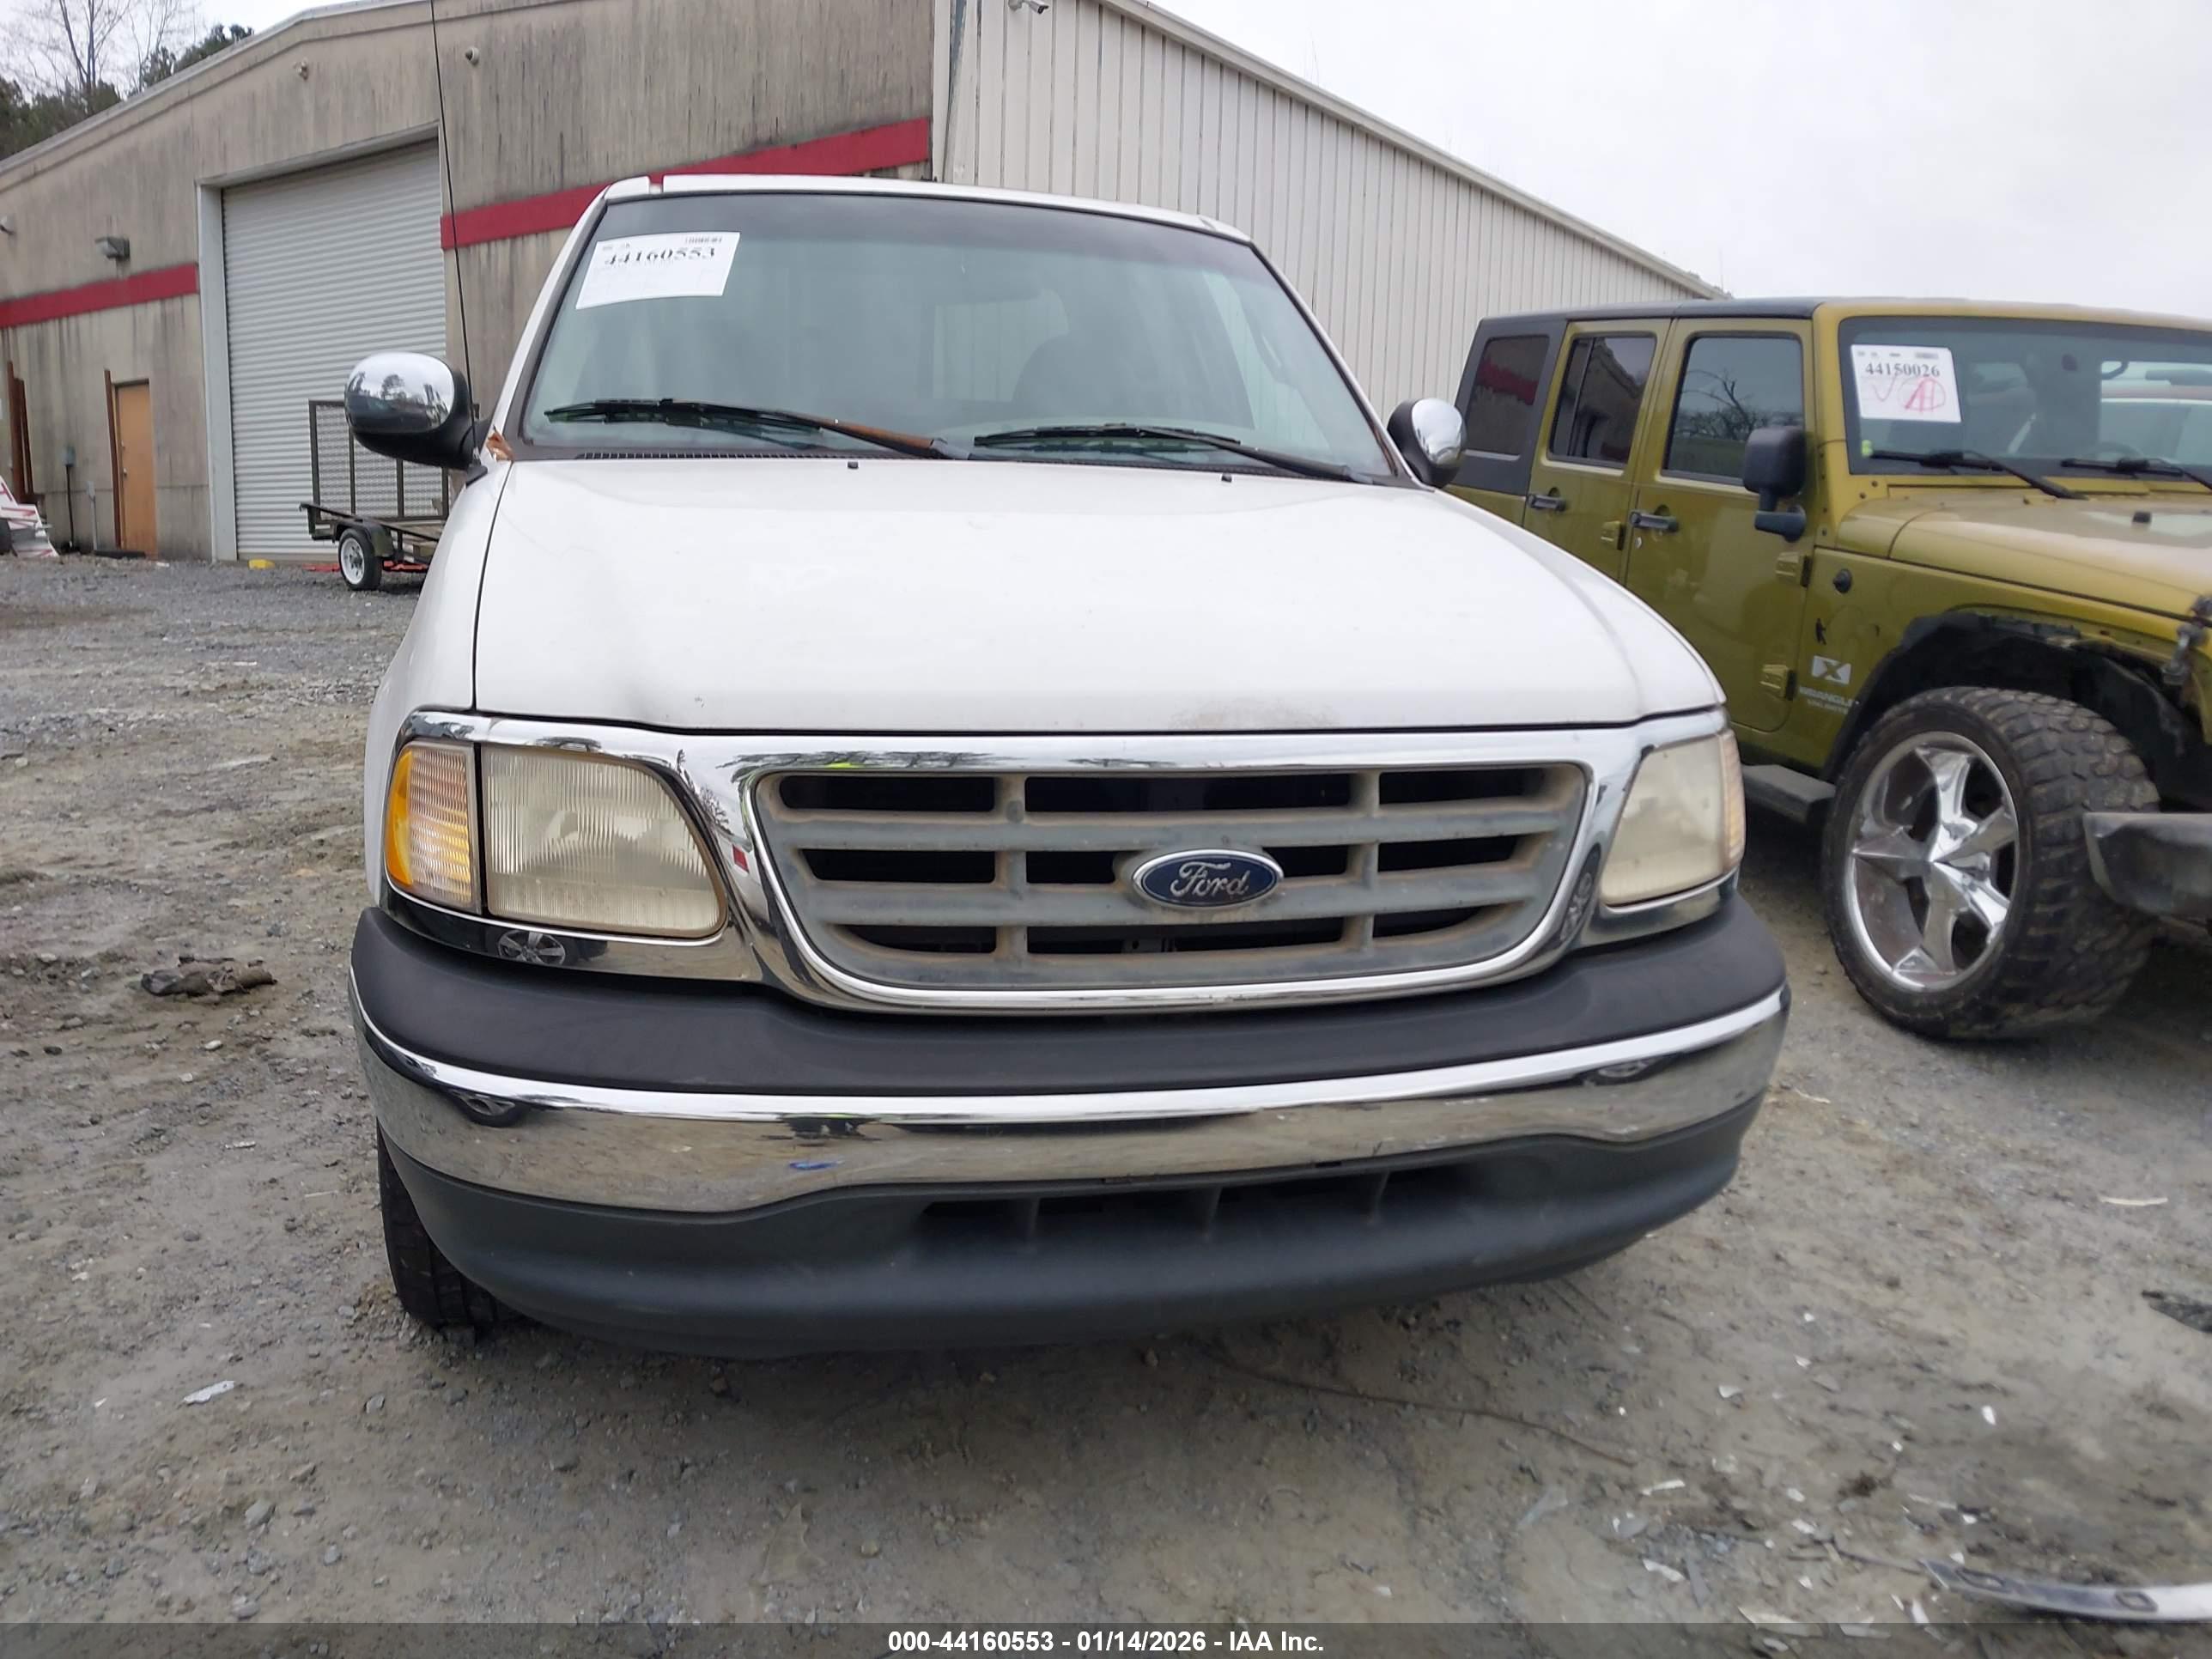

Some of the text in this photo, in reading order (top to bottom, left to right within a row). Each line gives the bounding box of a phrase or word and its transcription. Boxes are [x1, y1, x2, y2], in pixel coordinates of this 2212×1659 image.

[604, 246, 715, 265] 44160553
[1865, 362, 1941, 378] 44150026
[1170, 860, 1251, 897] Ford
